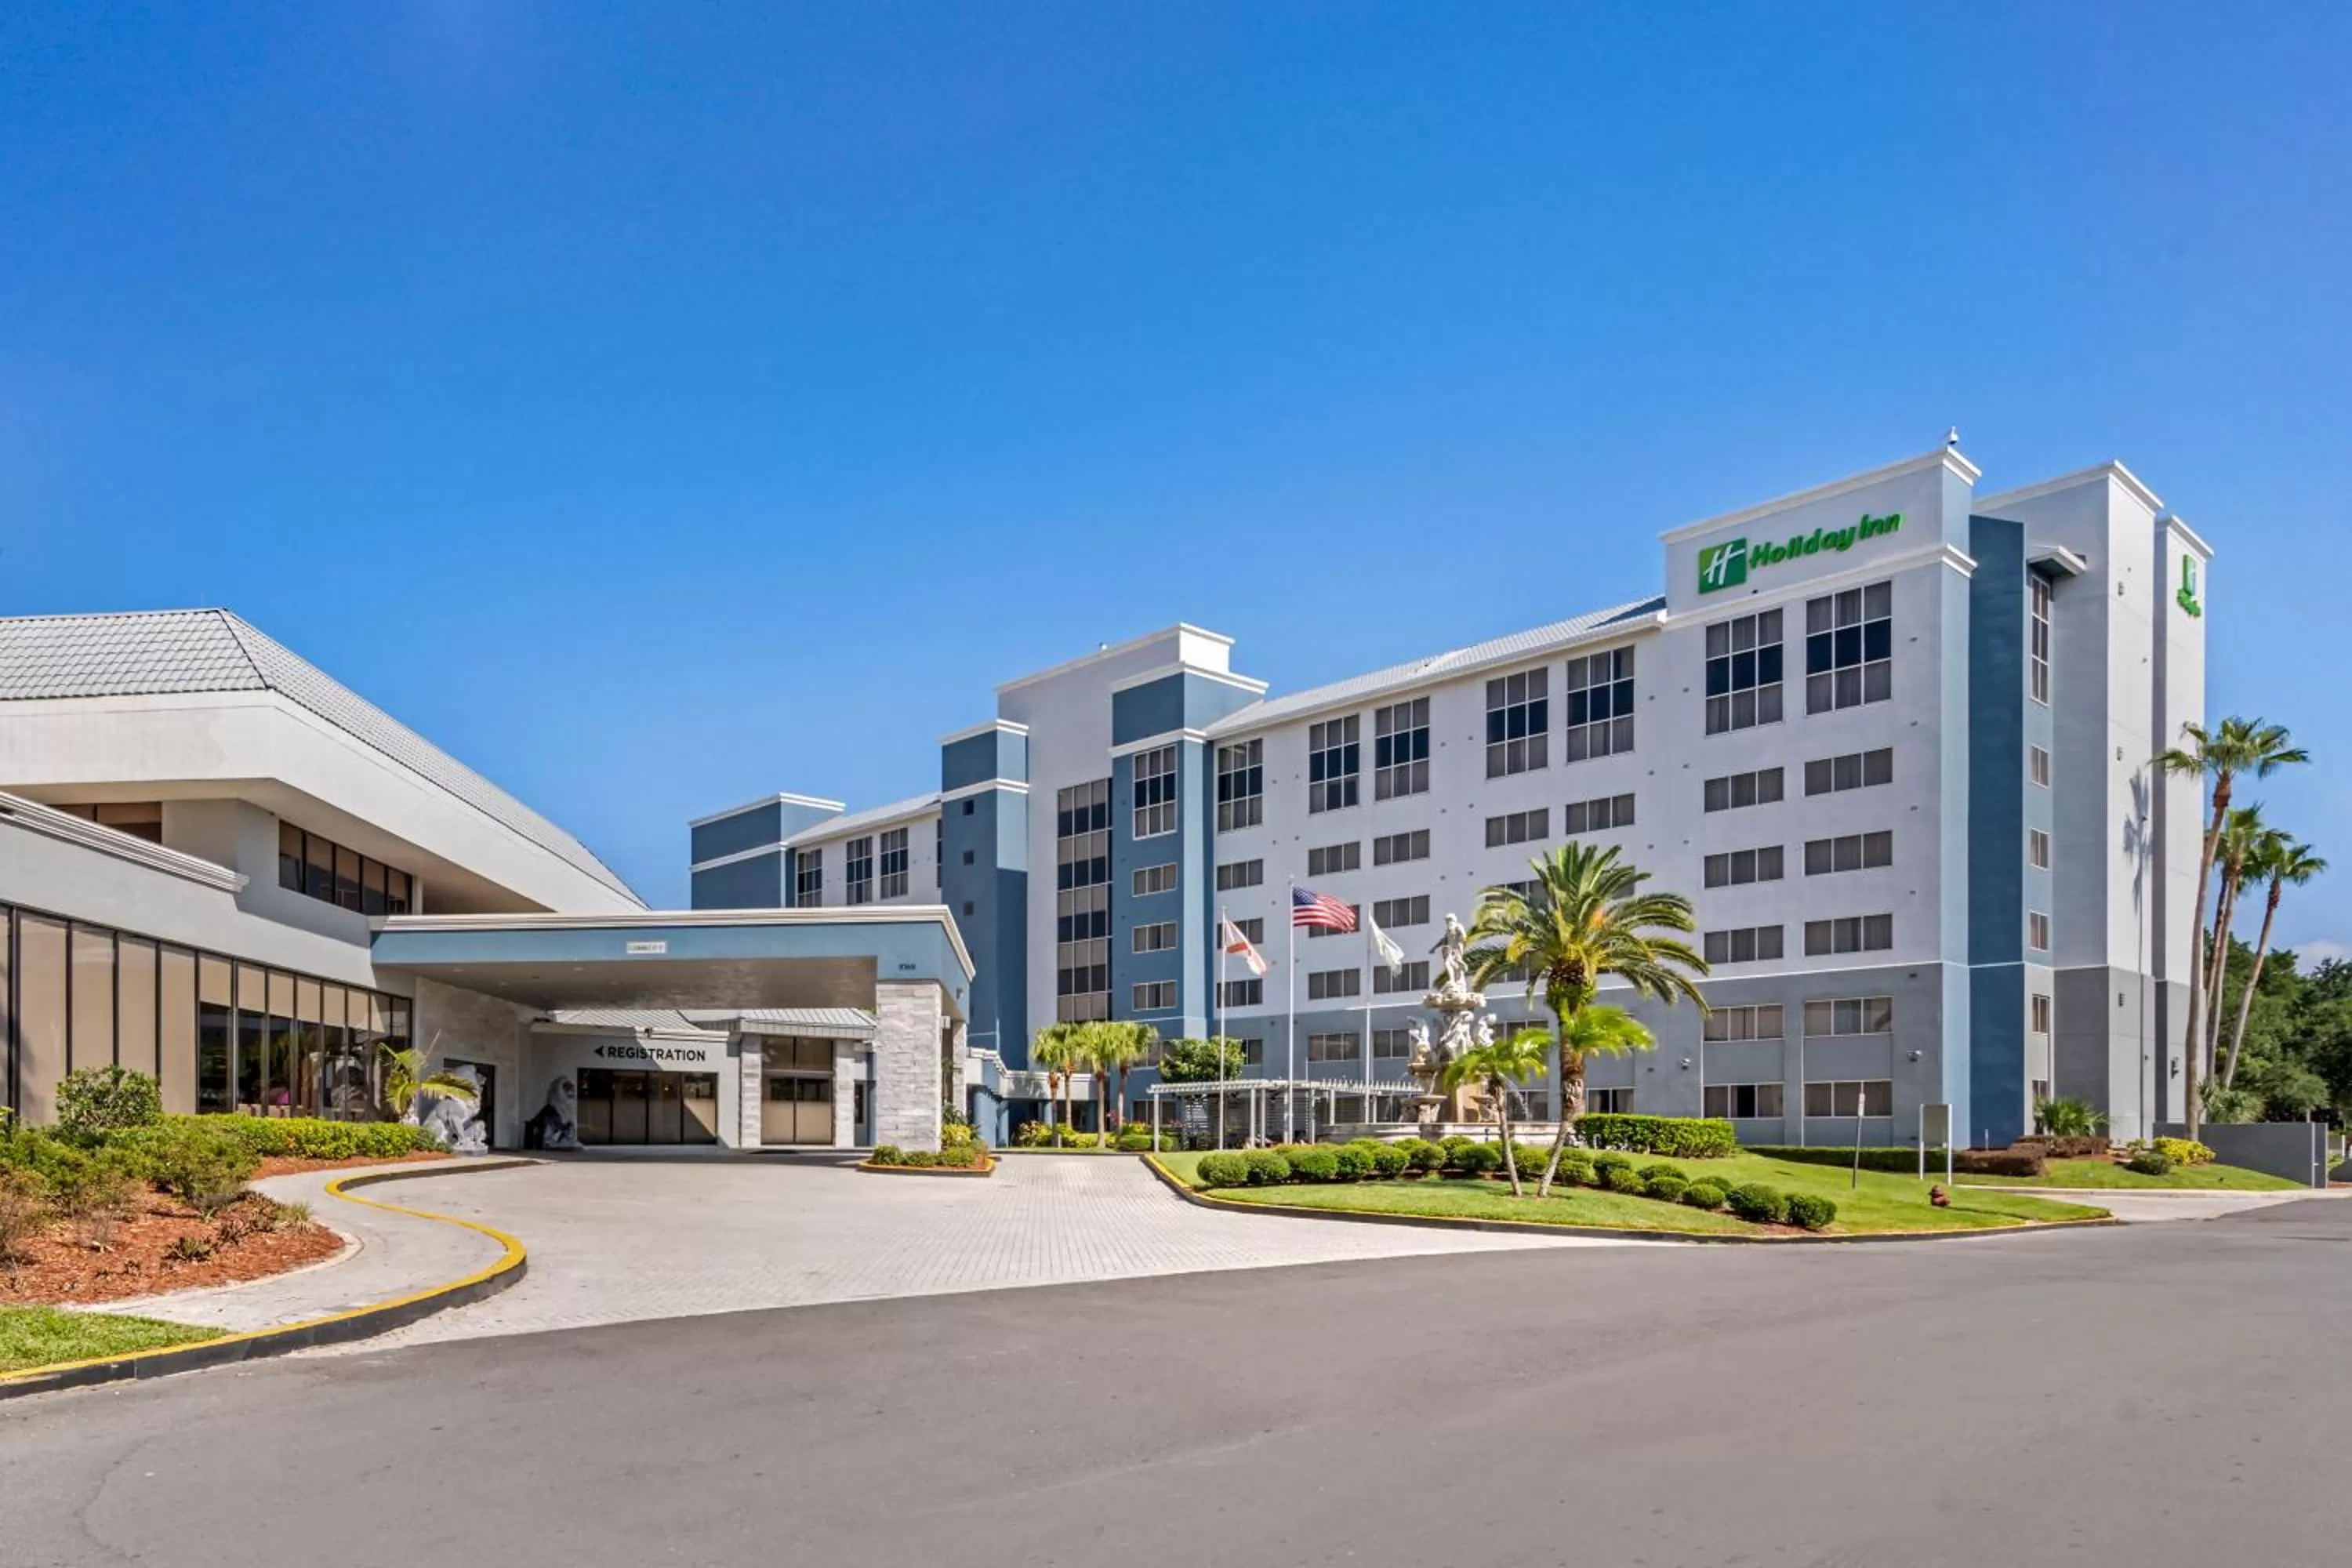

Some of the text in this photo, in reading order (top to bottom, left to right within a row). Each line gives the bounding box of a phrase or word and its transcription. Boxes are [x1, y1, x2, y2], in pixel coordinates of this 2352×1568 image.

[1749, 514, 1902, 569] Holiday Inn
[608, 1046, 706, 1062] REGISTRATION
